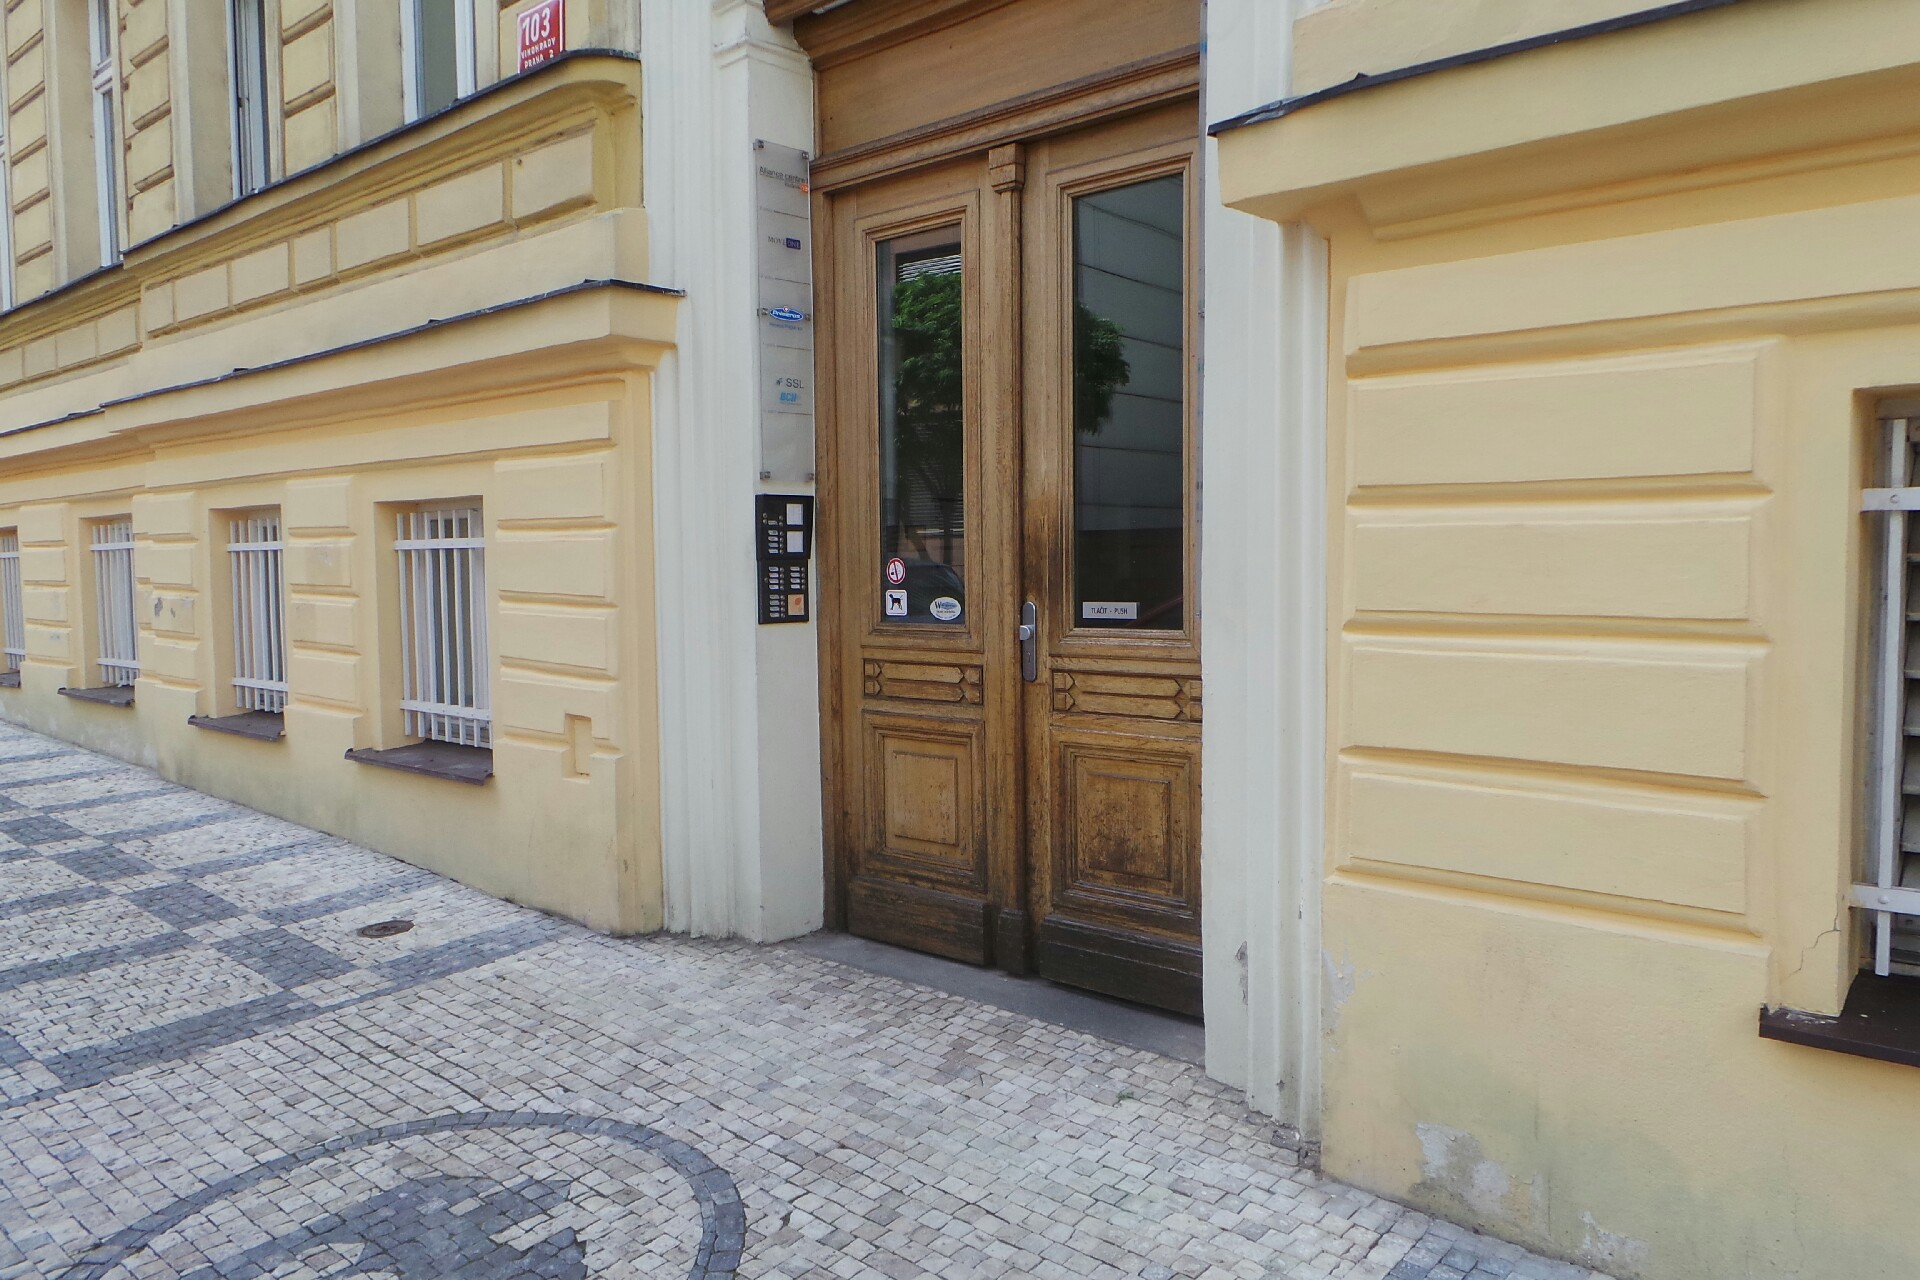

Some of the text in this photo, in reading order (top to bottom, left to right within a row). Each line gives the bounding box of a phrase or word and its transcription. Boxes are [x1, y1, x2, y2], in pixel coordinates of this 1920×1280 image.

[522, 7, 550, 46] 103
[524, 49, 554, 69] PRAHA 2
[786, 377, 805, 389] SSL
[1114, 607, 1128, 615] PUSH
